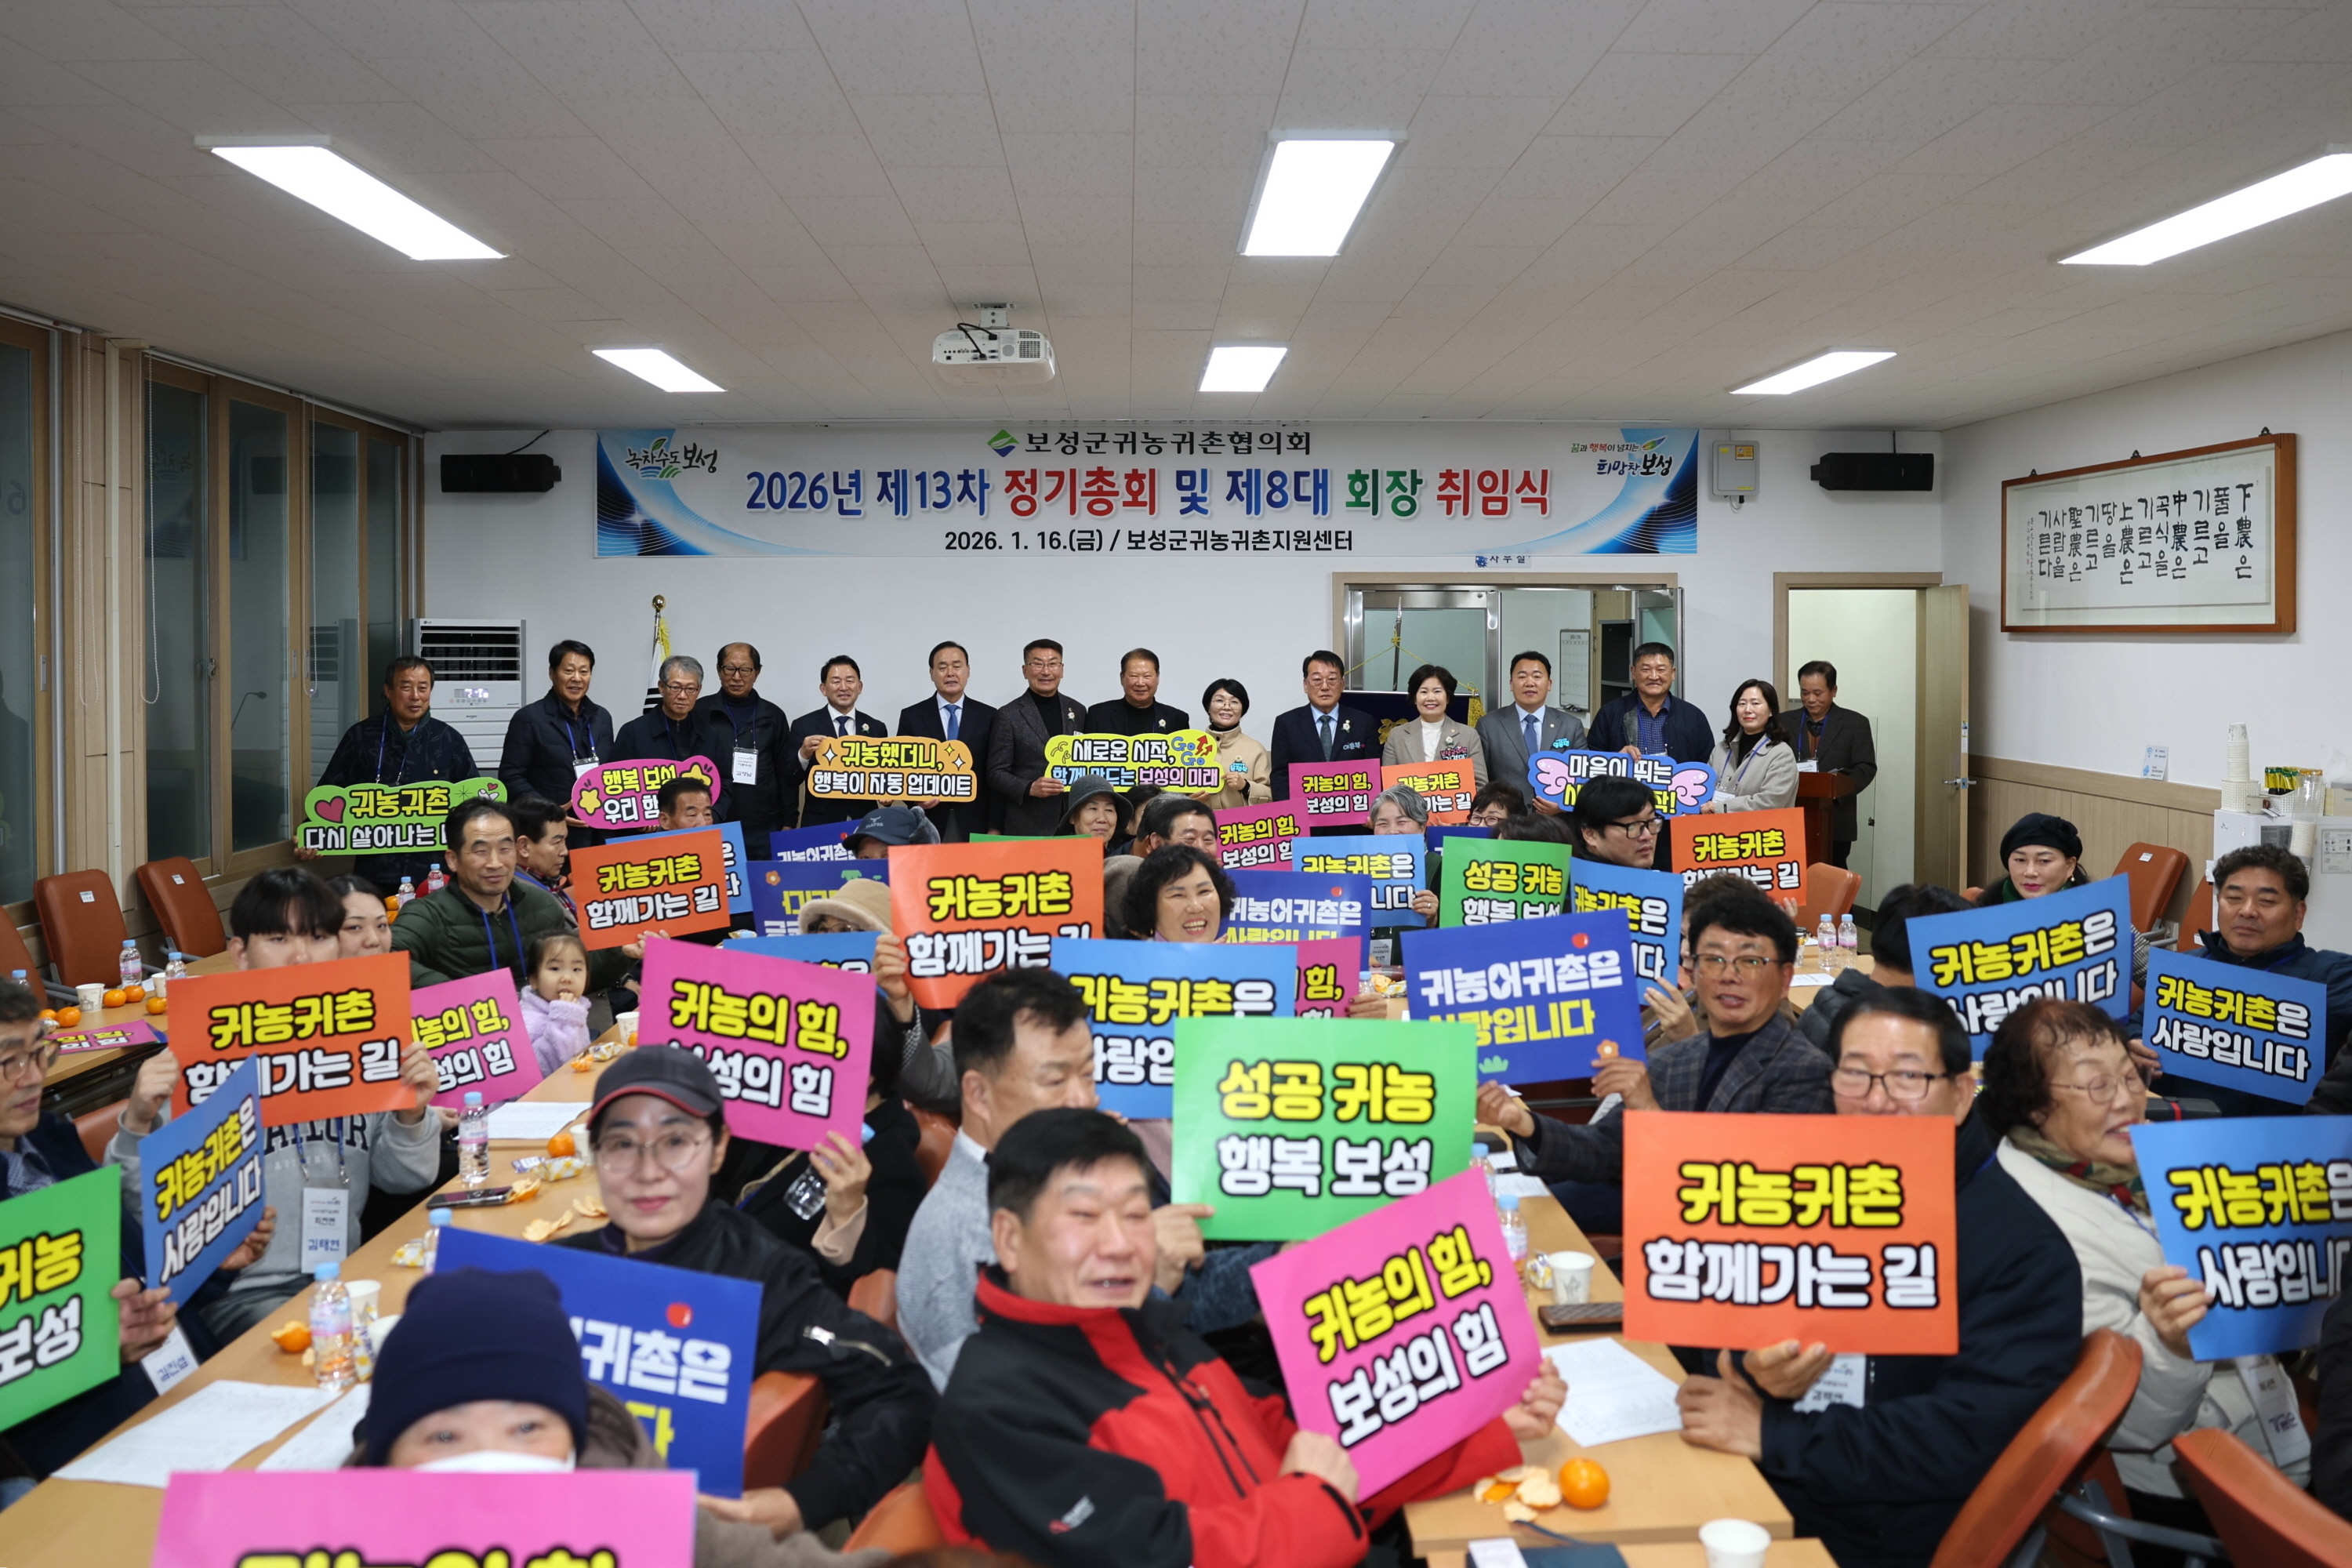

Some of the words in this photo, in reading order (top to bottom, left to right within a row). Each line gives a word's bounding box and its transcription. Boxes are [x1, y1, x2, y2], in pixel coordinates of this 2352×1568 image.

[625, 448, 681, 470] 녹차수도
[682, 442, 718, 474] 보성
[1025, 430, 1311, 456] 보성군귀농귀촌협의회
[1570, 443, 1588, 453] 꿈과
[1589, 442, 1615, 452] 행복이
[1617, 443, 1640, 452] 넘치는
[1596, 459, 1640, 476] 희망찬
[1641, 452, 1673, 477] 보성
[746, 469, 862, 516] 2026년
[877, 469, 989, 517] 제13차
[1004, 466, 1156, 517] 정기총회
[1176, 469, 1210, 516] 및
[1225, 469, 1329, 516] 제8대
[1345, 468, 1422, 517] 회장
[1437, 469, 1549, 517] 취임식
[945, 532, 1002, 550] 2026.
[1011, 531, 1028, 551] 1.
[1037, 531, 1104, 554] 16.(금)
[1127, 529, 1353, 552] 보성군귀농귀촌지원센터
[841, 740, 942, 770] 귀농했더니,
[1073, 739, 1127, 762] 새로운
[1133, 739, 1175, 764] 시작,
[1570, 754, 1628, 778] 마음이
[602, 768, 641, 795] 행복
[814, 771, 864, 797] 행복이
[869, 772, 903, 795] 자동
[906, 771, 973, 797] 업데이트
[1138, 767, 1185, 786] 보성의
[1188, 768, 1219, 787] 미래
[1302, 775, 1350, 793] 귀농의
[1352, 772, 1373, 791] 힘,
[350, 786, 451, 818] 귀농귀촌
[603, 796, 640, 823] 우리
[1307, 796, 1350, 814] 보성의
[1352, 794, 1368, 812] 힘
[1454, 793, 1472, 811] 길
[303, 826, 347, 851] 다시
[351, 824, 436, 849] 살아나는
[1218, 819, 1273, 845] 귀농의
[1275, 815, 1301, 836] 힘,
[1693, 829, 1785, 861] 귀농귀촌
[597, 854, 702, 892] 귀농귀촌
[1222, 844, 1275, 869] 보성의
[1465, 861, 1519, 892] 성공
[1523, 864, 1563, 895] 귀농
[1777, 862, 1800, 889] 길
[586, 892, 690, 930] 함께가는
[693, 884, 720, 912] 길
[928, 870, 1073, 920] 귀농귀촌
[1229, 897, 1362, 925] 귀농어귀촌은
[1463, 898, 1516, 925] 행복
[906, 928, 1051, 976] 함께가는
[1929, 909, 2116, 988] 귀농귀촌은
[1305, 965, 1345, 1001] 힘,
[1420, 950, 1623, 1007] 귀농어귀촌은
[210, 989, 375, 1049] 귀농귀촌
[470, 998, 510, 1035] 힘,
[670, 980, 789, 1045] 귀농의
[797, 1000, 849, 1058] 힘,
[2156, 975, 2310, 1039] 귀농귀촌은
[360, 1039, 400, 1082] 길
[483, 1038, 515, 1076] 힘
[2151, 1018, 2310, 1081] 사랑입니다
[791, 1062, 833, 1118] 힘
[1218, 1060, 1323, 1120] 성공
[1333, 1062, 1436, 1123] 귀농
[156, 1098, 256, 1220] 귀농귀촌은
[1217, 1135, 1323, 1196] 행복
[1331, 1138, 1433, 1196] 보성
[1679, 1161, 1903, 1228] 귀농귀촌
[2168, 1161, 2352, 1229] 귀농귀촌은
[162, 1156, 263, 1283] 사랑입니다
[1643, 1239, 1872, 1308] 함께가는
[1883, 1243, 1939, 1308] 길
[1302, 1246, 1434, 1364] 귀농의
[1428, 1224, 1493, 1300] 힘,
[1327, 1327, 1461, 1449] 보성의
[1452, 1301, 1509, 1377] 힘
